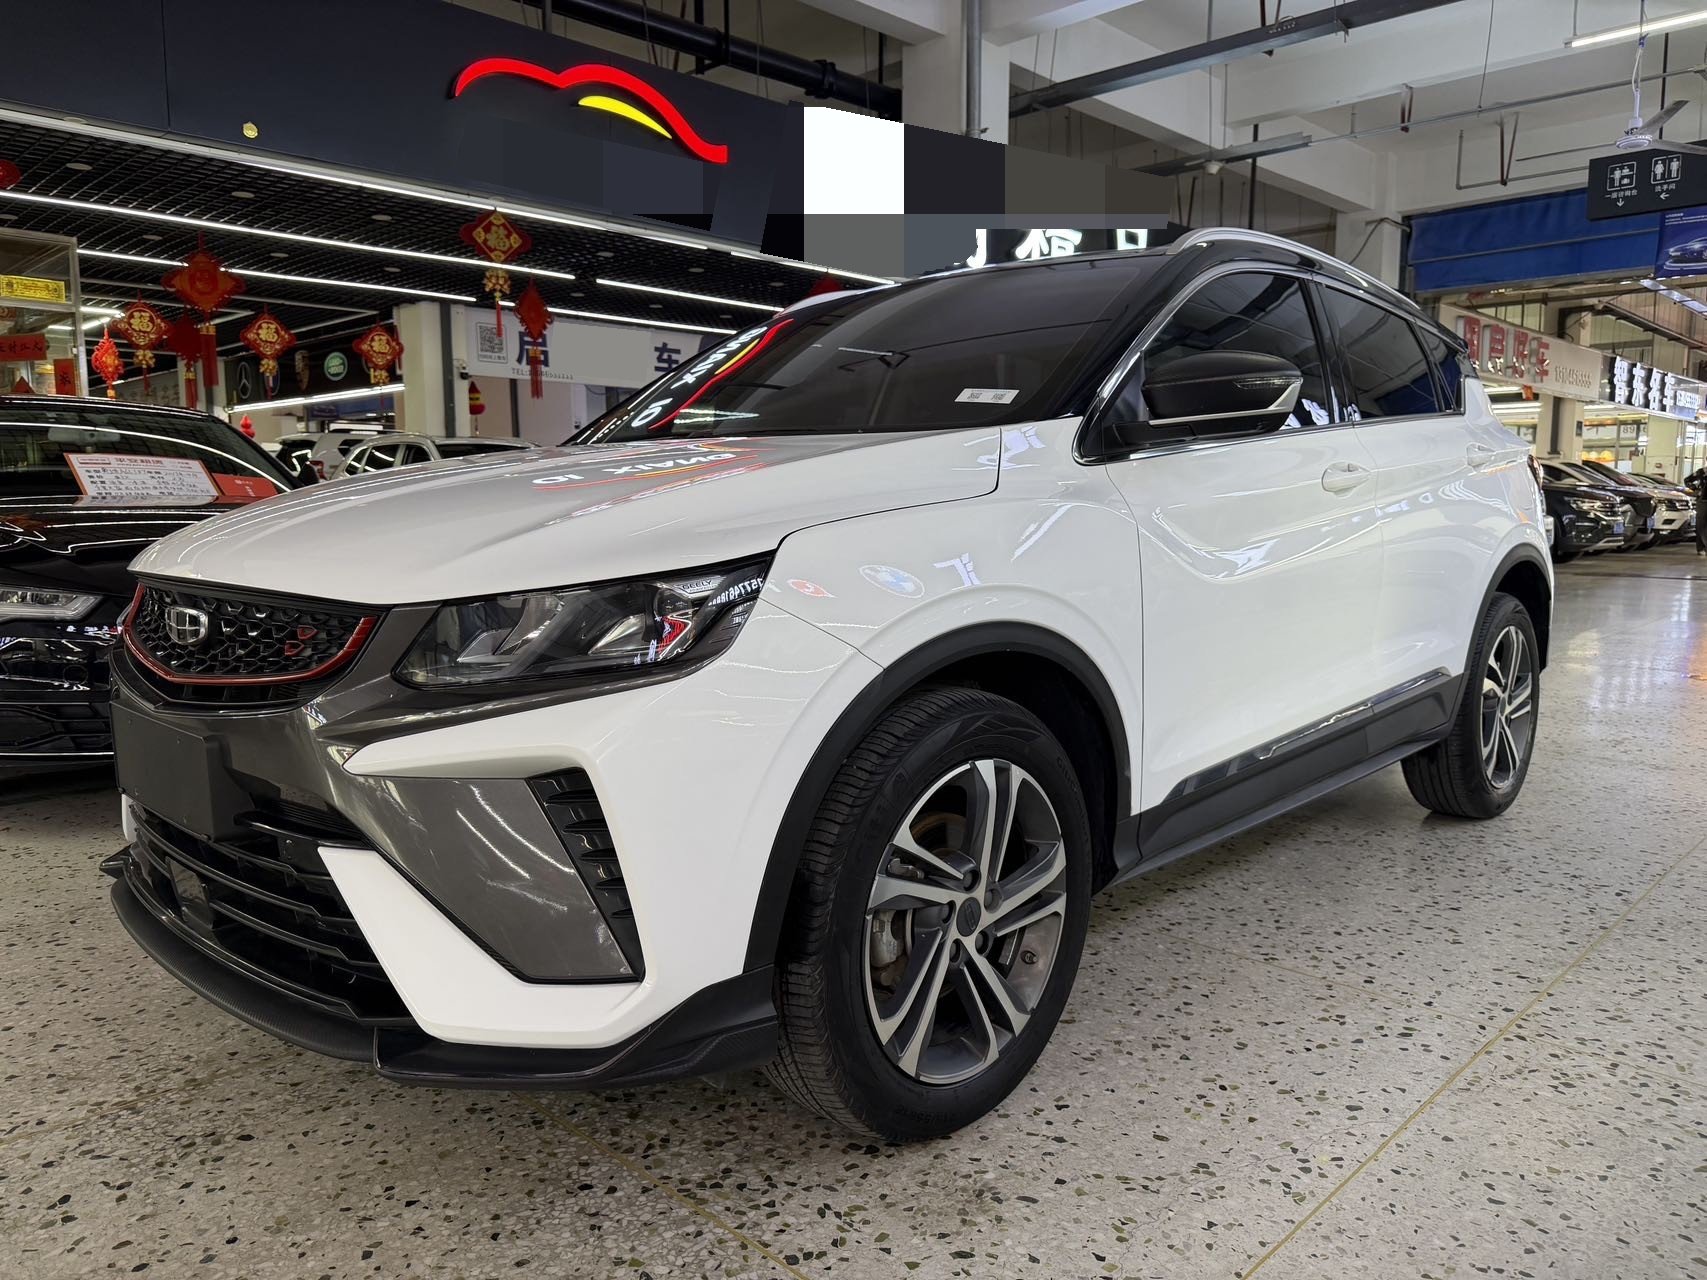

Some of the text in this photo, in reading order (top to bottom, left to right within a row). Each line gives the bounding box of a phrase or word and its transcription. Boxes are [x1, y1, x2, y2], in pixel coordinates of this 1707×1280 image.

[486, 226, 511, 251] 福
[130, 311, 154, 332] 福
[258, 323, 280, 343] 福
[371, 335, 390, 353] 福
